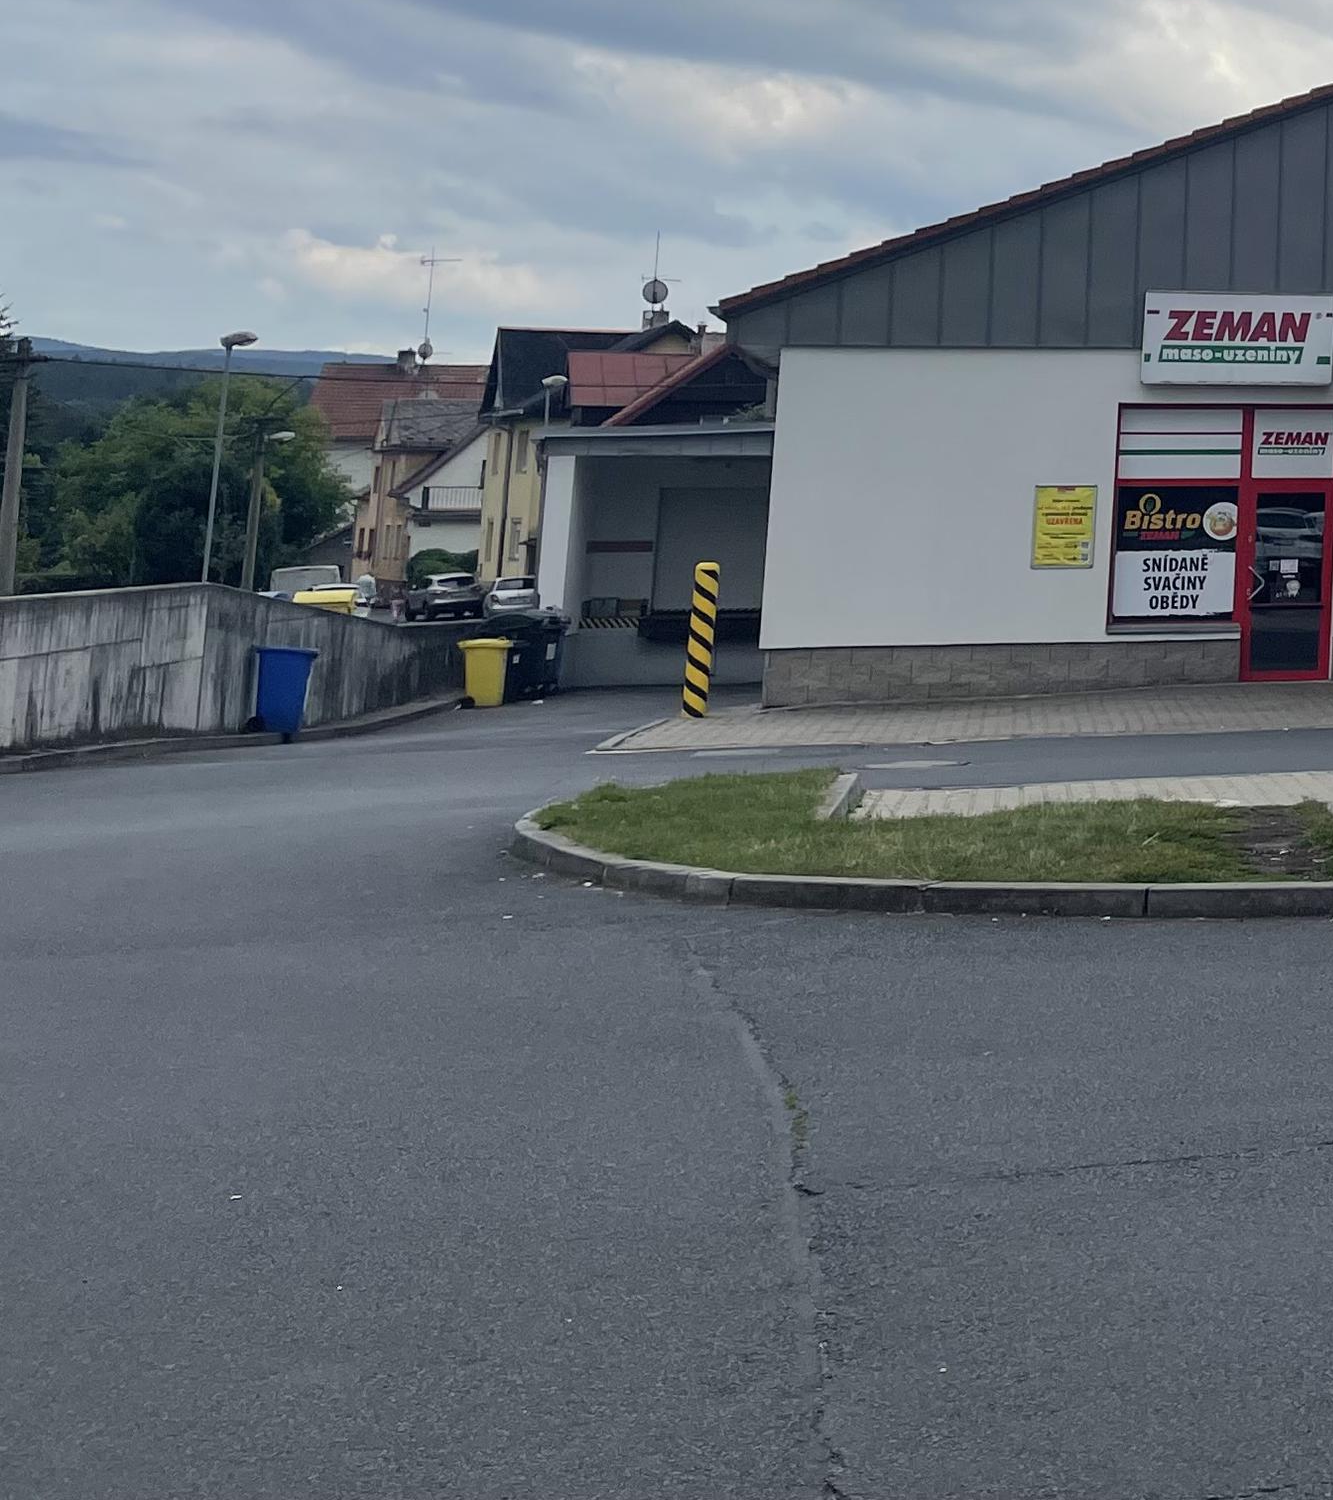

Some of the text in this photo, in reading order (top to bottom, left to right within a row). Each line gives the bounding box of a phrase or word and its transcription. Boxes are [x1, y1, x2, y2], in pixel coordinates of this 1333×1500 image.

[1163, 310, 1313, 343] ZEMAN
[1161, 347, 1301, 365] maso-uzeniny
[1260, 431, 1330, 446] ZEMAN
[1124, 495, 1202, 530] Bistro
[1142, 554, 1209, 573] SNÍDANĚ
[1143, 573, 1207, 592] SVAČINY
[1149, 592, 1200, 610] OBĚDY
